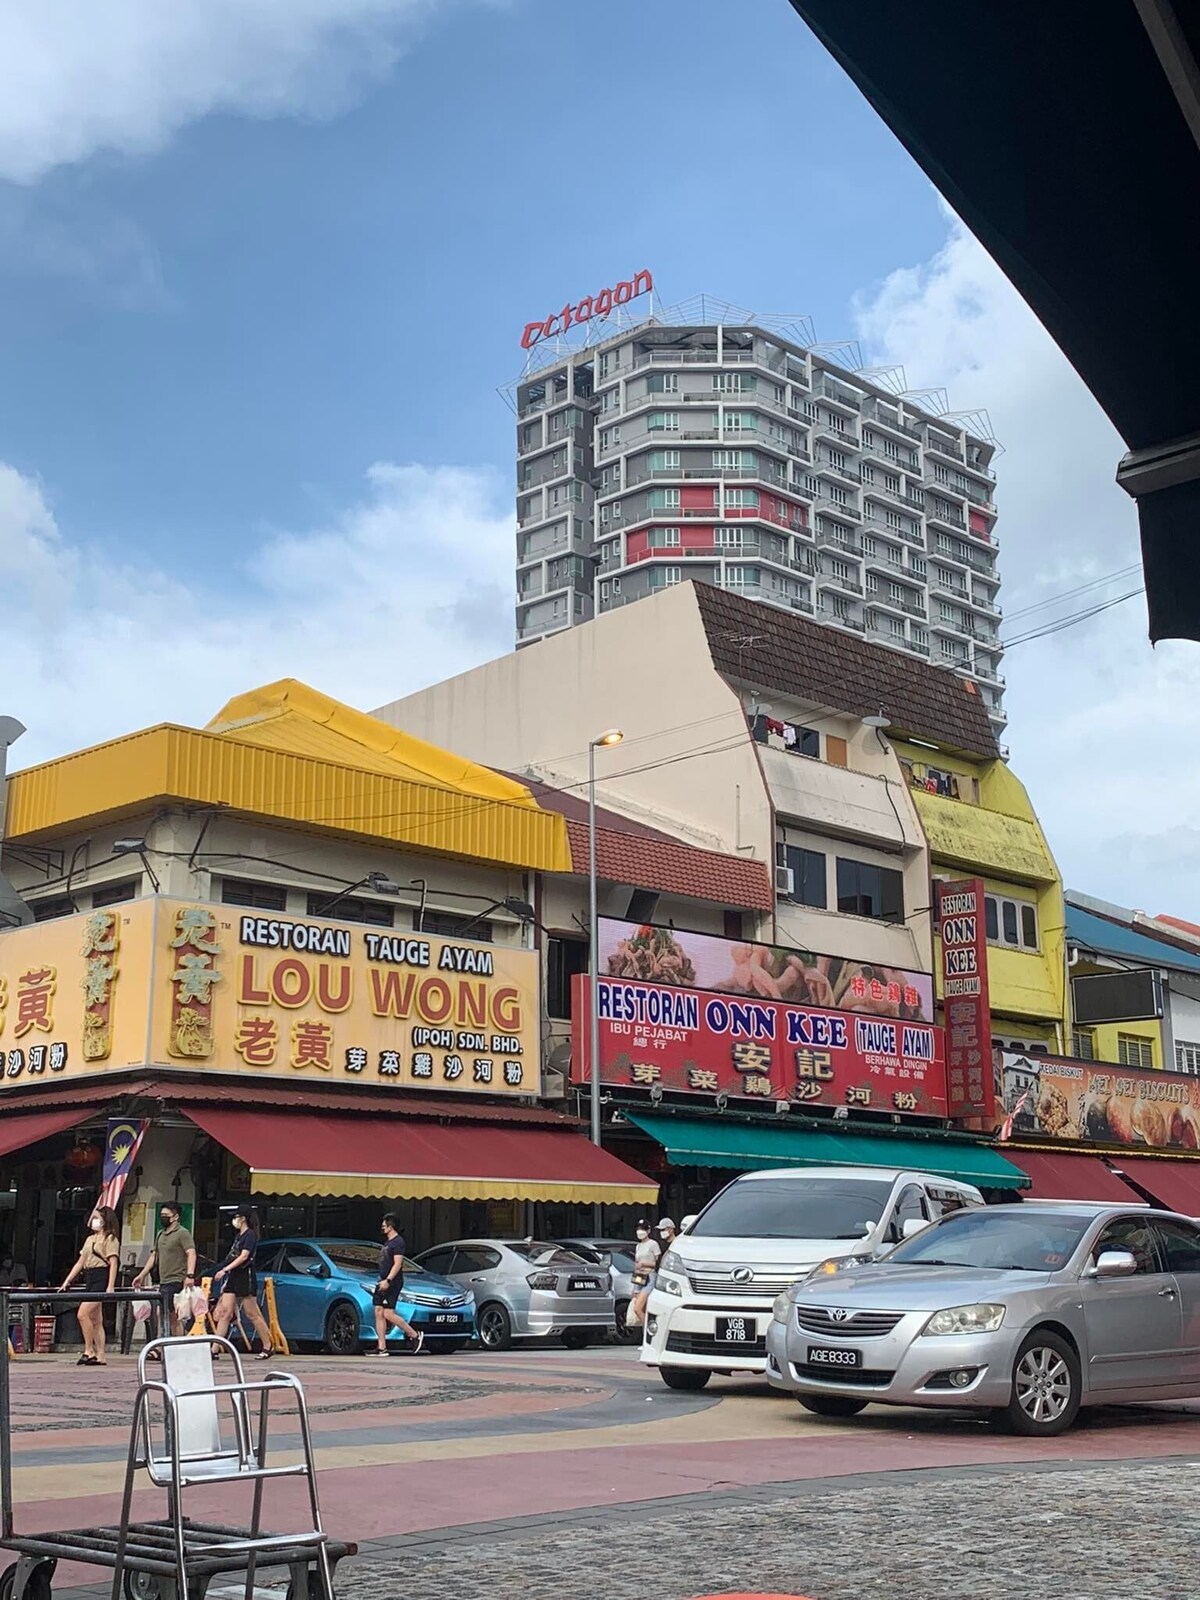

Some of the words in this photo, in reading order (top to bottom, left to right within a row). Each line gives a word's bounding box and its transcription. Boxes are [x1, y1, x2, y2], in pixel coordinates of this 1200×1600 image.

[521, 268, 653, 348] octagon
[941, 892, 976, 916] RESTORAN
[220, 922, 232, 931] TM
[944, 916, 976, 945] ONN
[241, 916, 350, 955] RESTORAN
[366, 934, 430, 966] TAUGE
[440, 946, 493, 975] AYAM
[945, 947, 977, 976] KEE
[0, 966, 54, 1036] 黃
[240, 953, 352, 1011] LOU
[370, 967, 522, 1031] WONG
[597, 982, 699, 1031] RESTORAN
[705, 999, 776, 1039] ONN
[785, 1010, 848, 1049] KEE
[854, 1017, 897, 1056] (TAUGE
[902, 1027, 935, 1064] AYAM)
[610, 1022, 631, 1035] IBU
[634, 1025, 688, 1042] PEJABAT
[413, 1026, 455, 1050] (IPOH)
[458, 1031, 489, 1051] SDN.
[492, 1035, 524, 1054] BHD.
[0, 1042, 67, 1079] 沙河粉
[734, 1041, 834, 1080] 安記
[865, 1054, 901, 1067] BERHAWA
[903, 1059, 928, 1071] DINGIN
[1040, 1062, 1061, 1077] KEDAI
[1062, 1065, 1083, 1080] BISKUT
[725, 1328, 746, 1341] 8718
[727, 1318, 745, 1330] VGB
[809, 1349, 856, 1365] AGE8333
